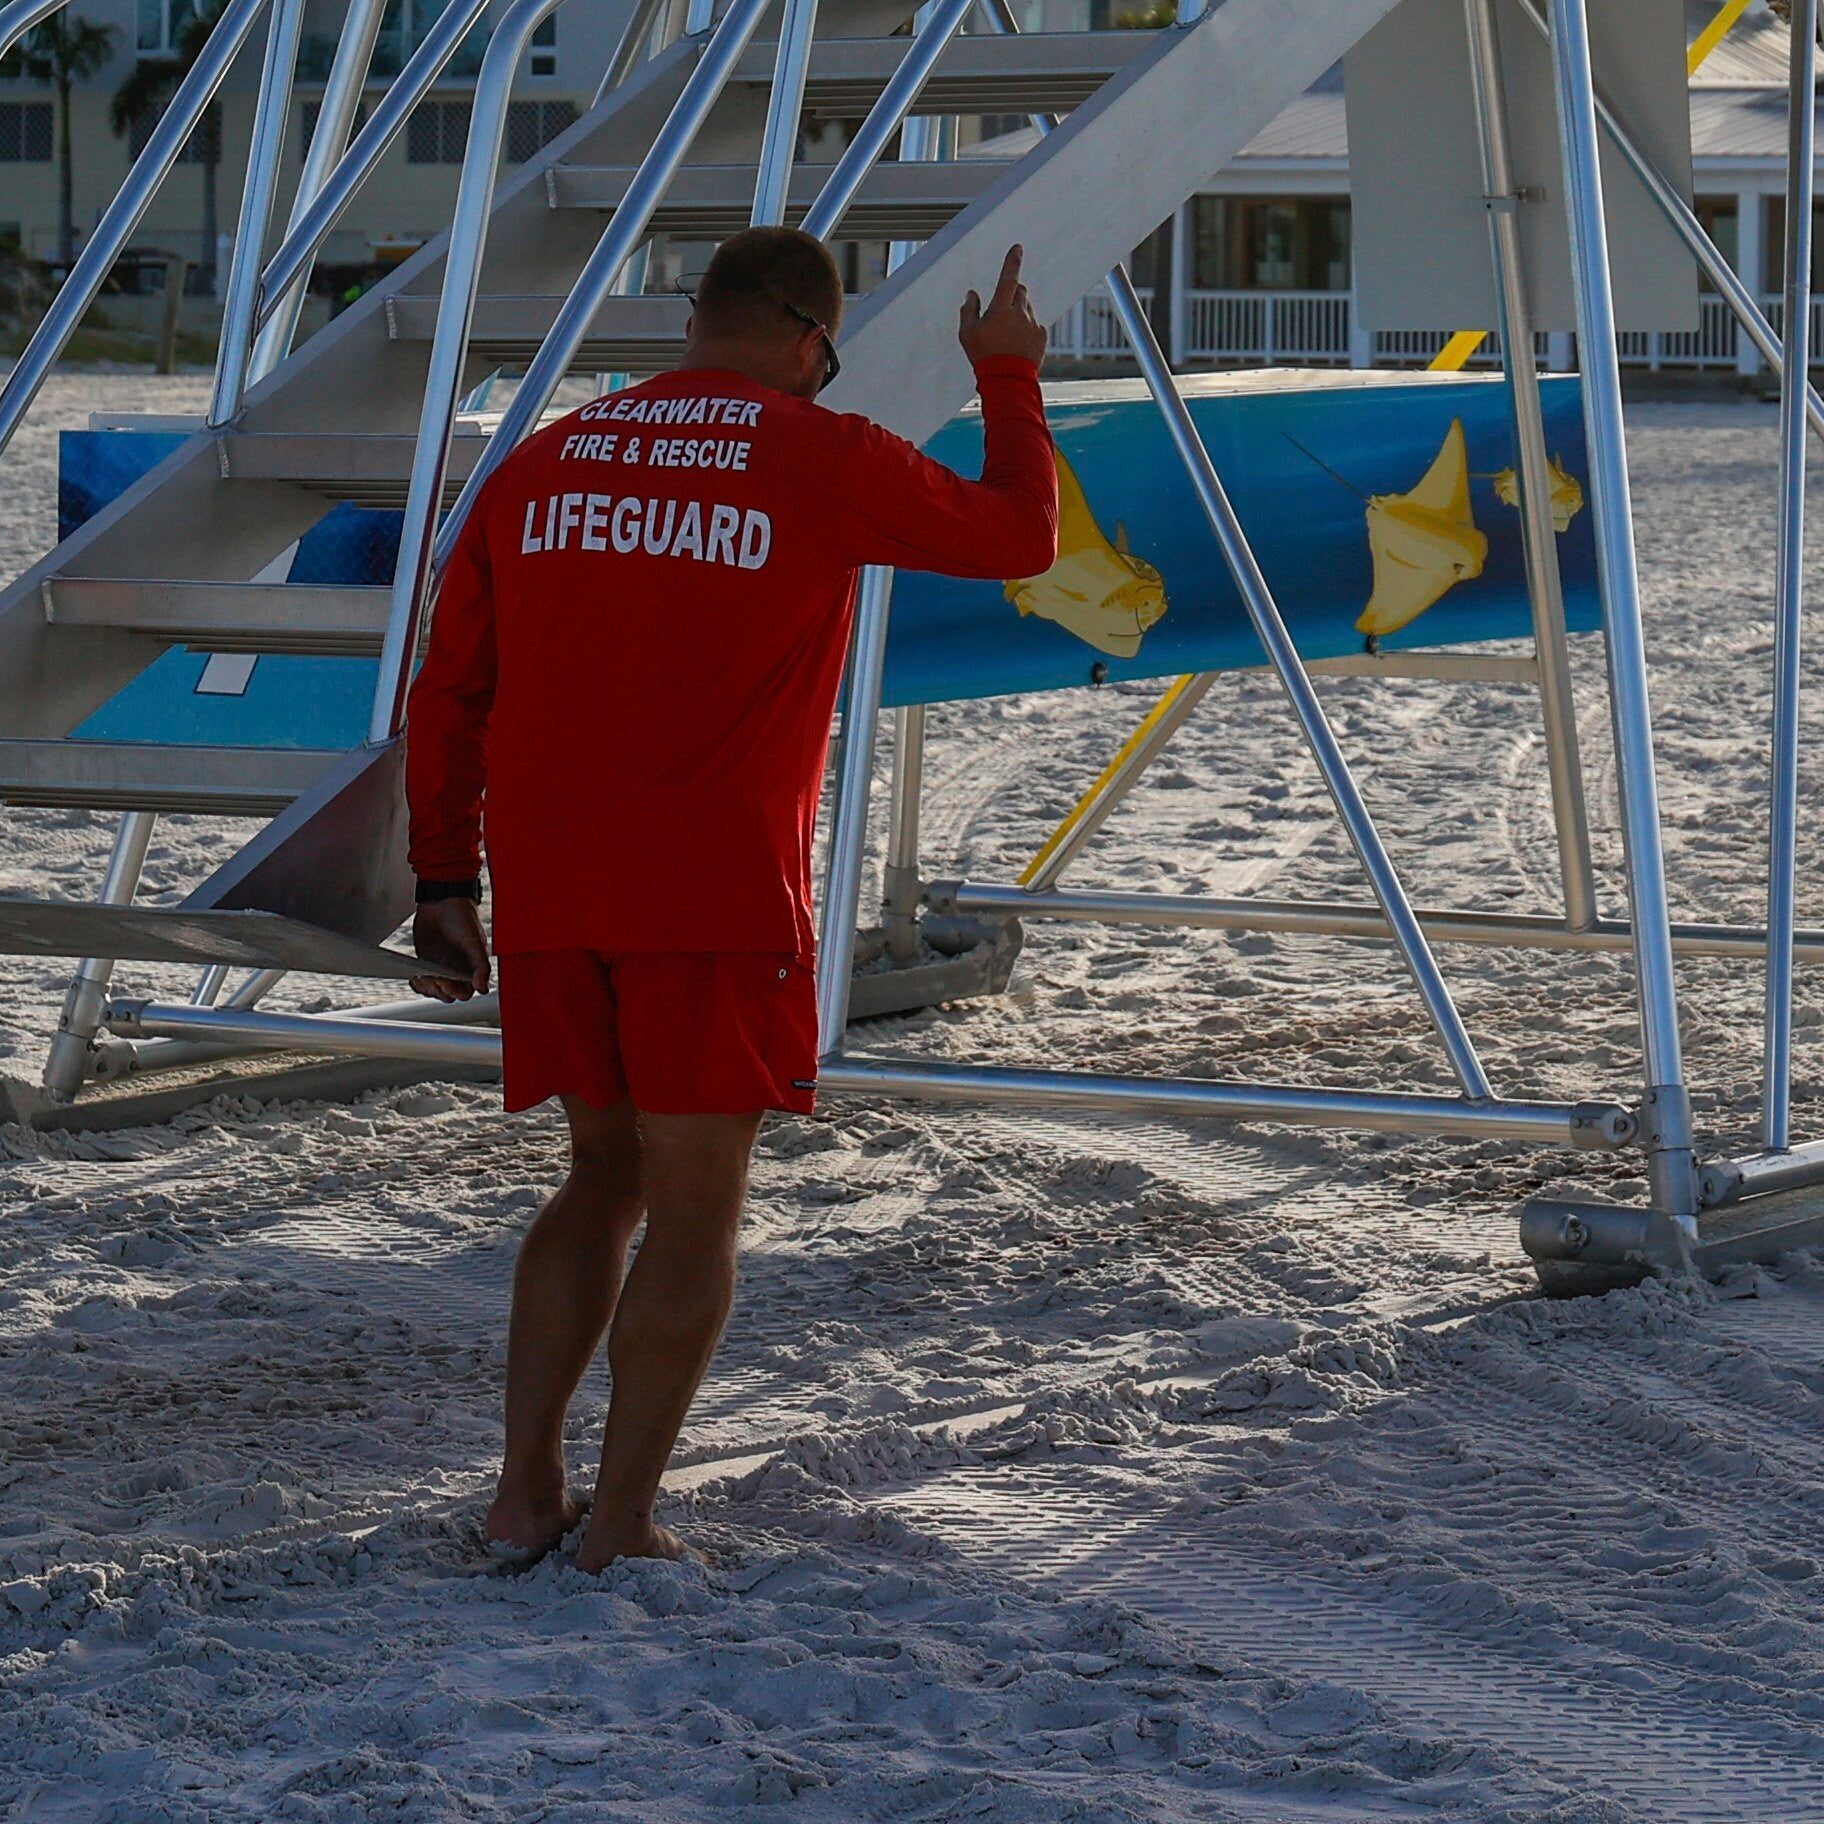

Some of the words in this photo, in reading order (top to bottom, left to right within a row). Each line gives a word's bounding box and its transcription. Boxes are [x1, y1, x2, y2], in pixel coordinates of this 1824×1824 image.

[580, 397, 763, 427] CLEARWATER
[559, 434, 619, 462] FIRE
[622, 437, 640, 464] &
[648, 439, 752, 471] RESCUE
[521, 492, 772, 570] LIFEGUARD
